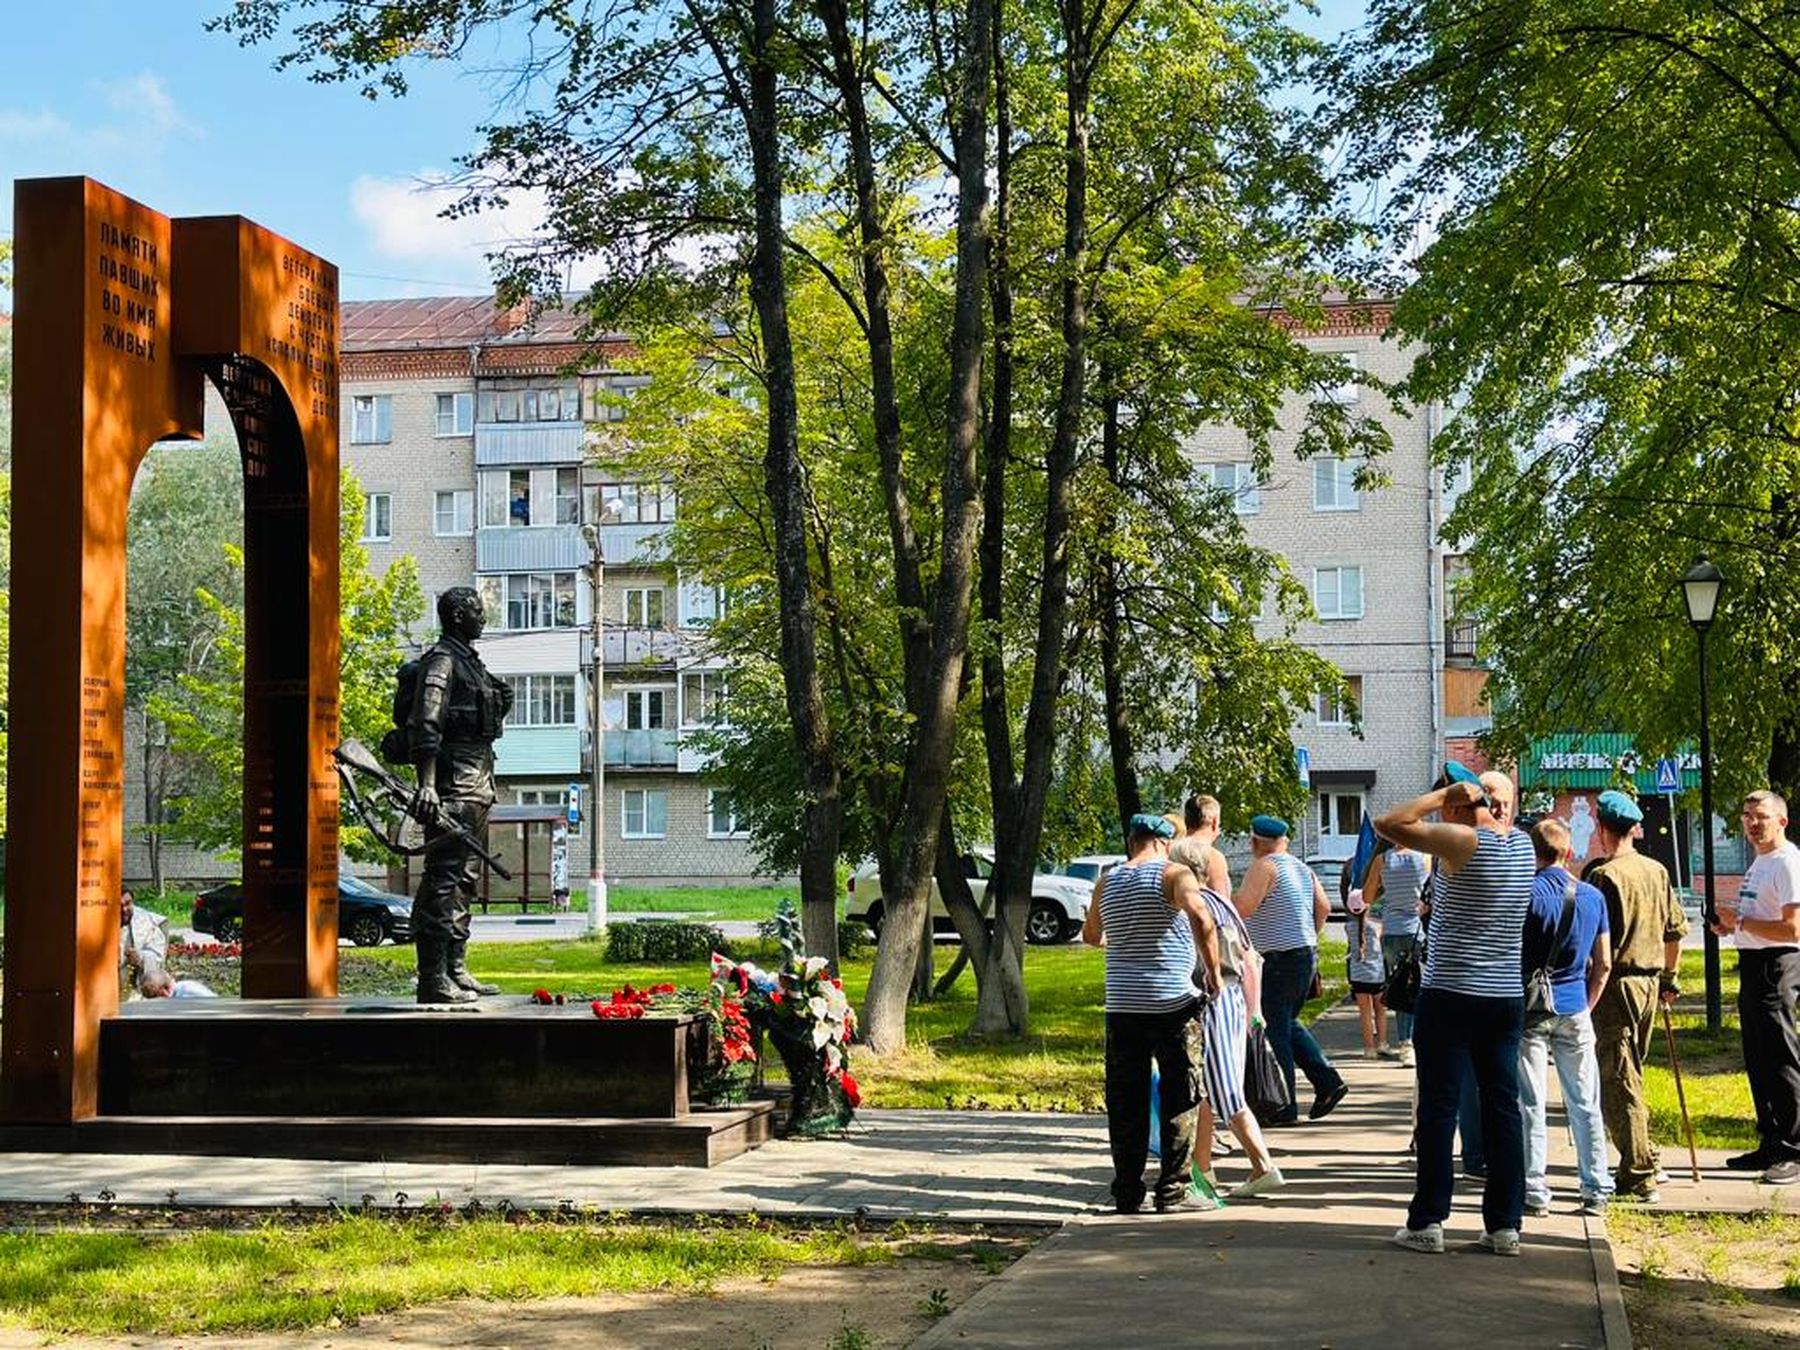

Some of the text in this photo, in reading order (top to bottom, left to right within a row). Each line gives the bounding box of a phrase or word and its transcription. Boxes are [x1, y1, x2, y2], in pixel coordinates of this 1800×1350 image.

[100, 221, 157, 267] ПАМЯТИ
[99, 255, 157, 298] ПАВШИХ
[102, 288, 155, 331] ВО ИМЯ
[102, 323, 155, 363] ЖИВЫХ
